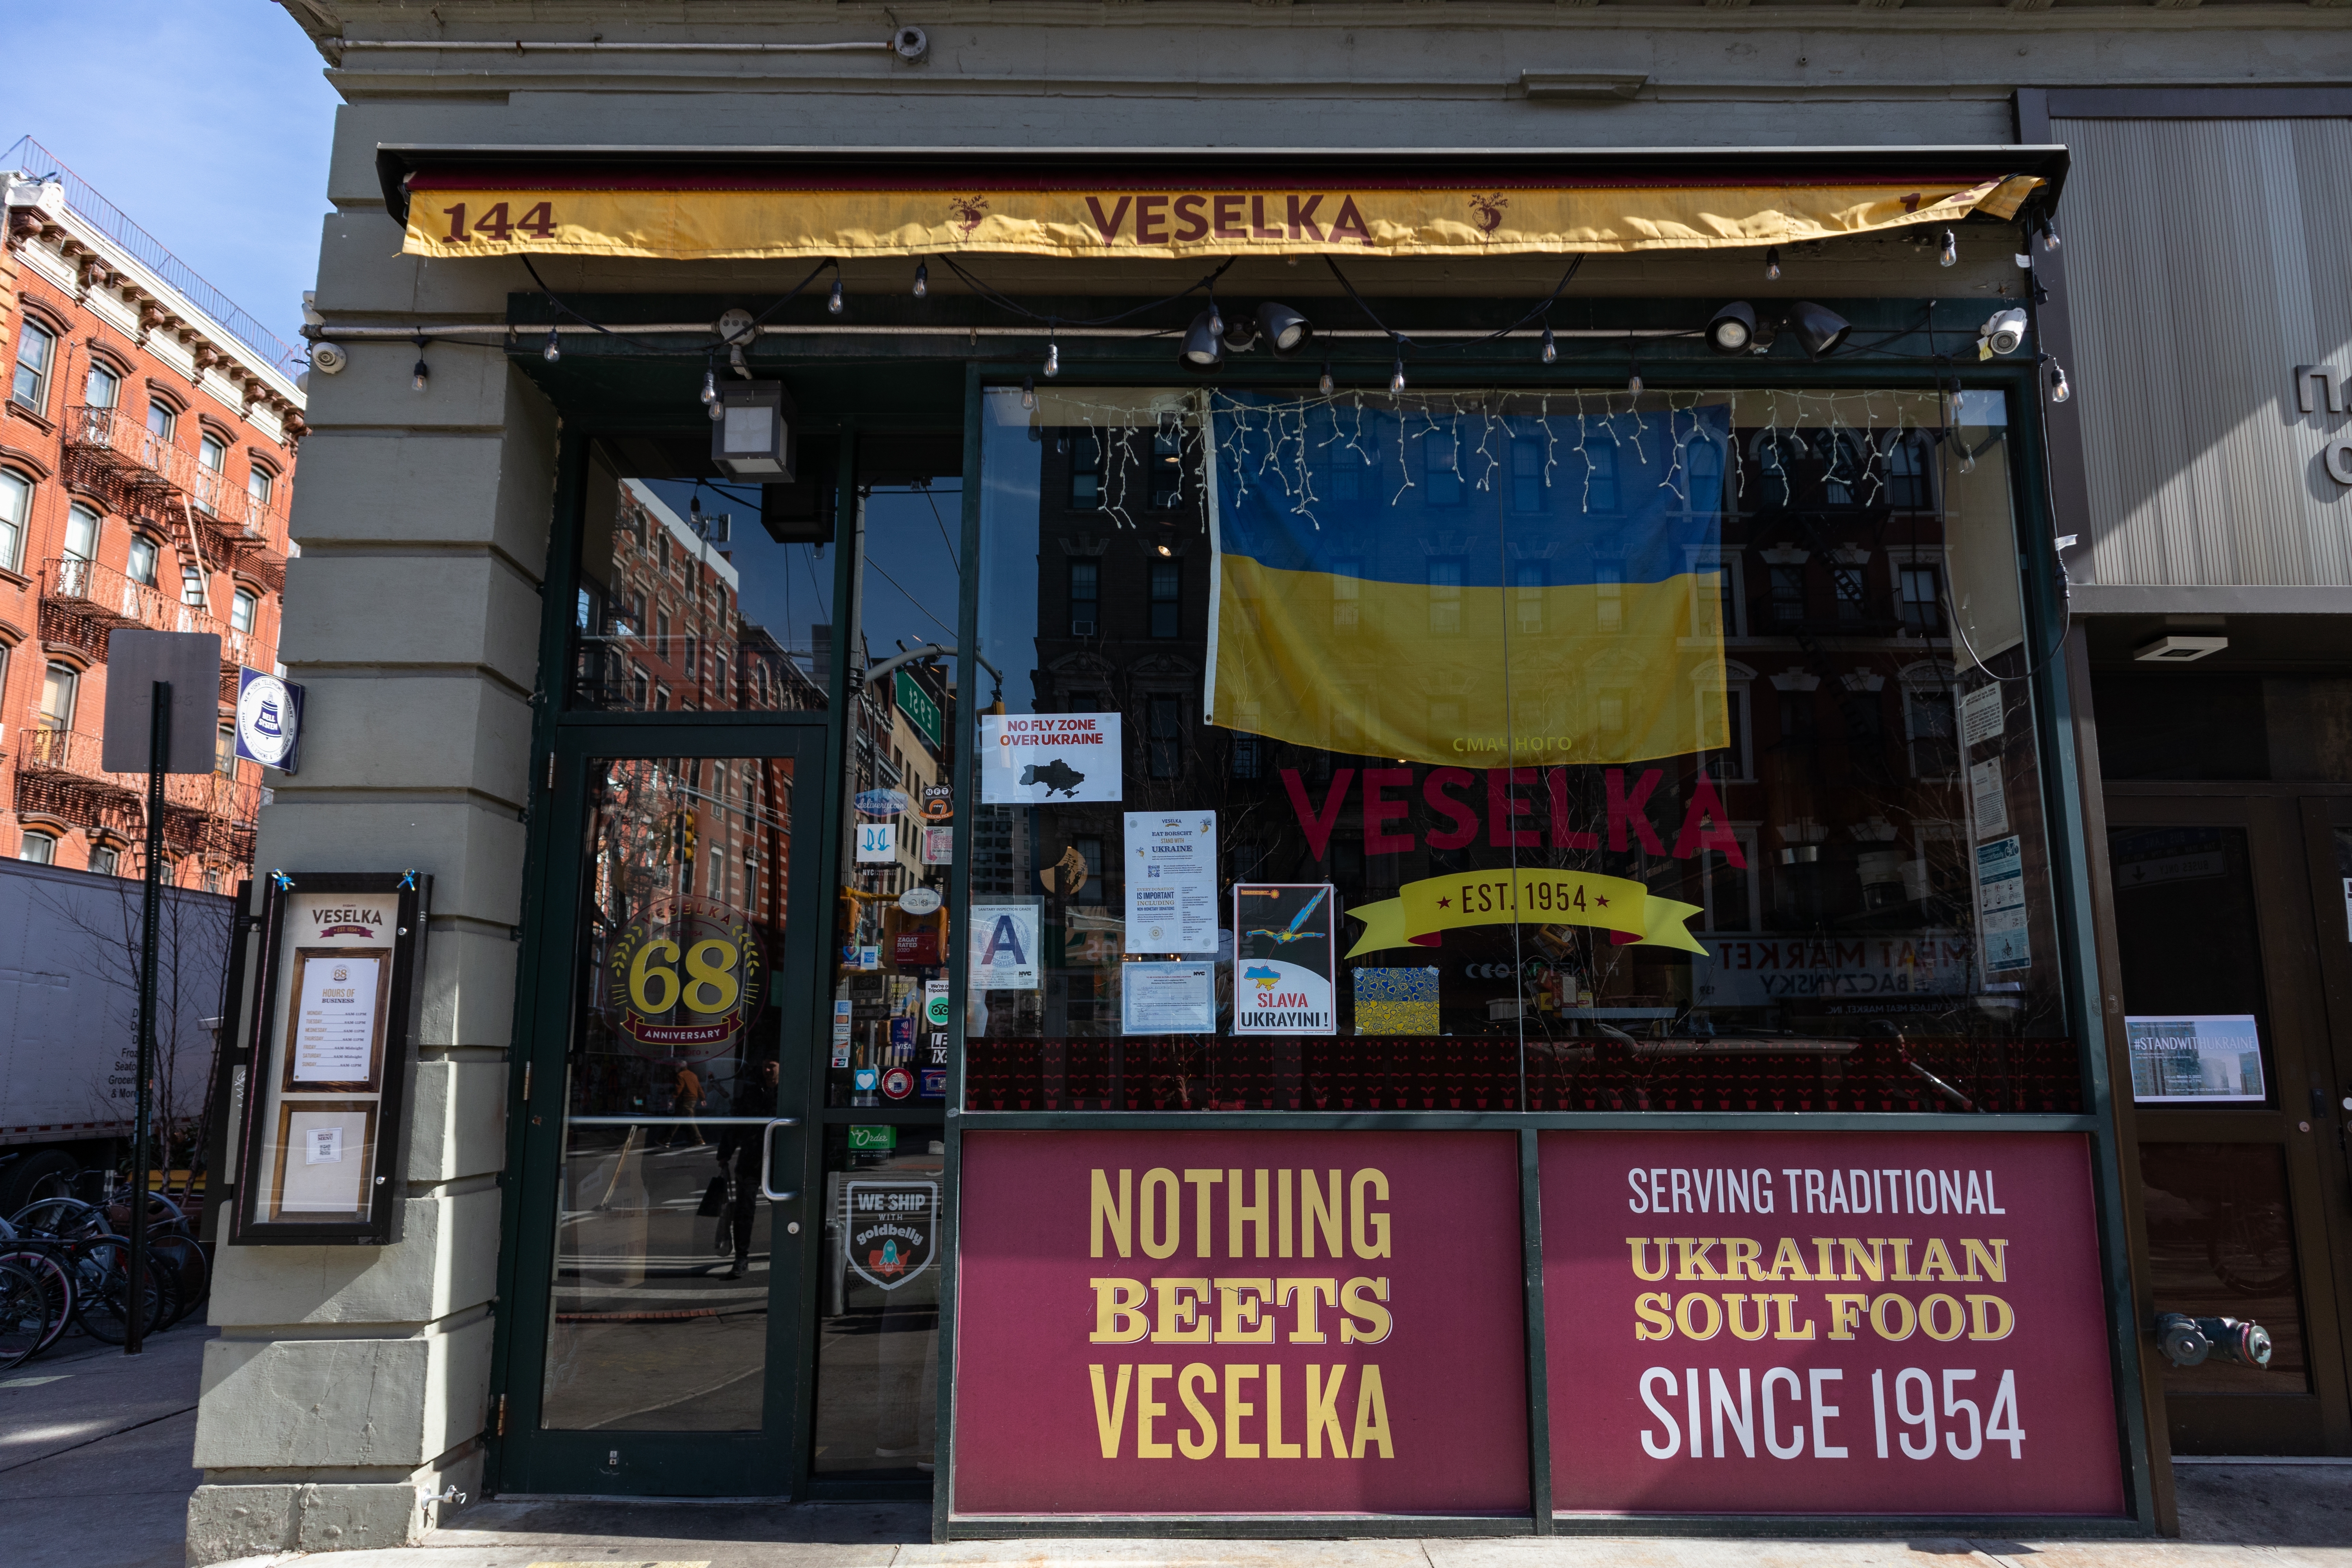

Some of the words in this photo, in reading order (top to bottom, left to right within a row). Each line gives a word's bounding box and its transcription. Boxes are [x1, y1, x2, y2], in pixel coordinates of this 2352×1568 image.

[442, 201, 557, 242] 144
[1085, 194, 1374, 248] VESELKA
[262, 679, 283, 692] TELEPHONE
[283, 692, 294, 718] COMPANY
[258, 718, 278, 730] SYSTEM
[262, 712, 275, 722] BELL
[1007, 720, 1028, 731] NO
[1031, 720, 1055, 731] FLY
[1058, 719, 1096, 731] ZONE
[1000, 734, 1039, 746] OVER
[1042, 733, 1103, 745] UKRAINE
[857, 798, 905, 813] delivery.com
[1280, 766, 1748, 869] VESELKA
[1461, 884, 1514, 914] EST.
[1524, 882, 1587, 913] 1954
[312, 909, 383, 926] VESELKA
[641, 902, 732, 926] VESELKA
[981, 915, 1027, 965] A
[334, 969, 347, 978] 68
[629, 939, 739, 1014] 68
[322, 988, 345, 997] HOURS
[347, 988, 356, 997] OF
[1257, 993, 1308, 1008] SLAVA
[644, 1029, 720, 1040] ANNIVERSARY
[2134, 1036, 2256, 1050] #STANDWITHUKRAINE
[122, 1047, 138, 1058] Froz
[114, 1061, 137, 1071] Seafo
[108, 1074, 136, 1085] Groceri
[111, 1088, 116, 1098] &
[855, 1129, 887, 1146] Order
[1628, 1168, 1773, 1214] SERVING
[1782, 1169, 2006, 1215] TRADITIONAL
[858, 1194, 884, 1211] WE
[887, 1194, 926, 1210] SHIP
[1090, 1168, 1391, 1259] NOTHING
[856, 1223, 924, 1246] goldbelly
[1625, 1237, 2009, 1283] UKRAINIAN
[1089, 1276, 1393, 1345] BEETS
[1635, 1292, 1816, 1341] SOUL
[1825, 1292, 2015, 1342] FOOD
[1089, 1362, 1396, 1459] VESELKA
[1639, 1366, 1849, 1460] SINCE
[1871, 1367, 2026, 1461] 1954
